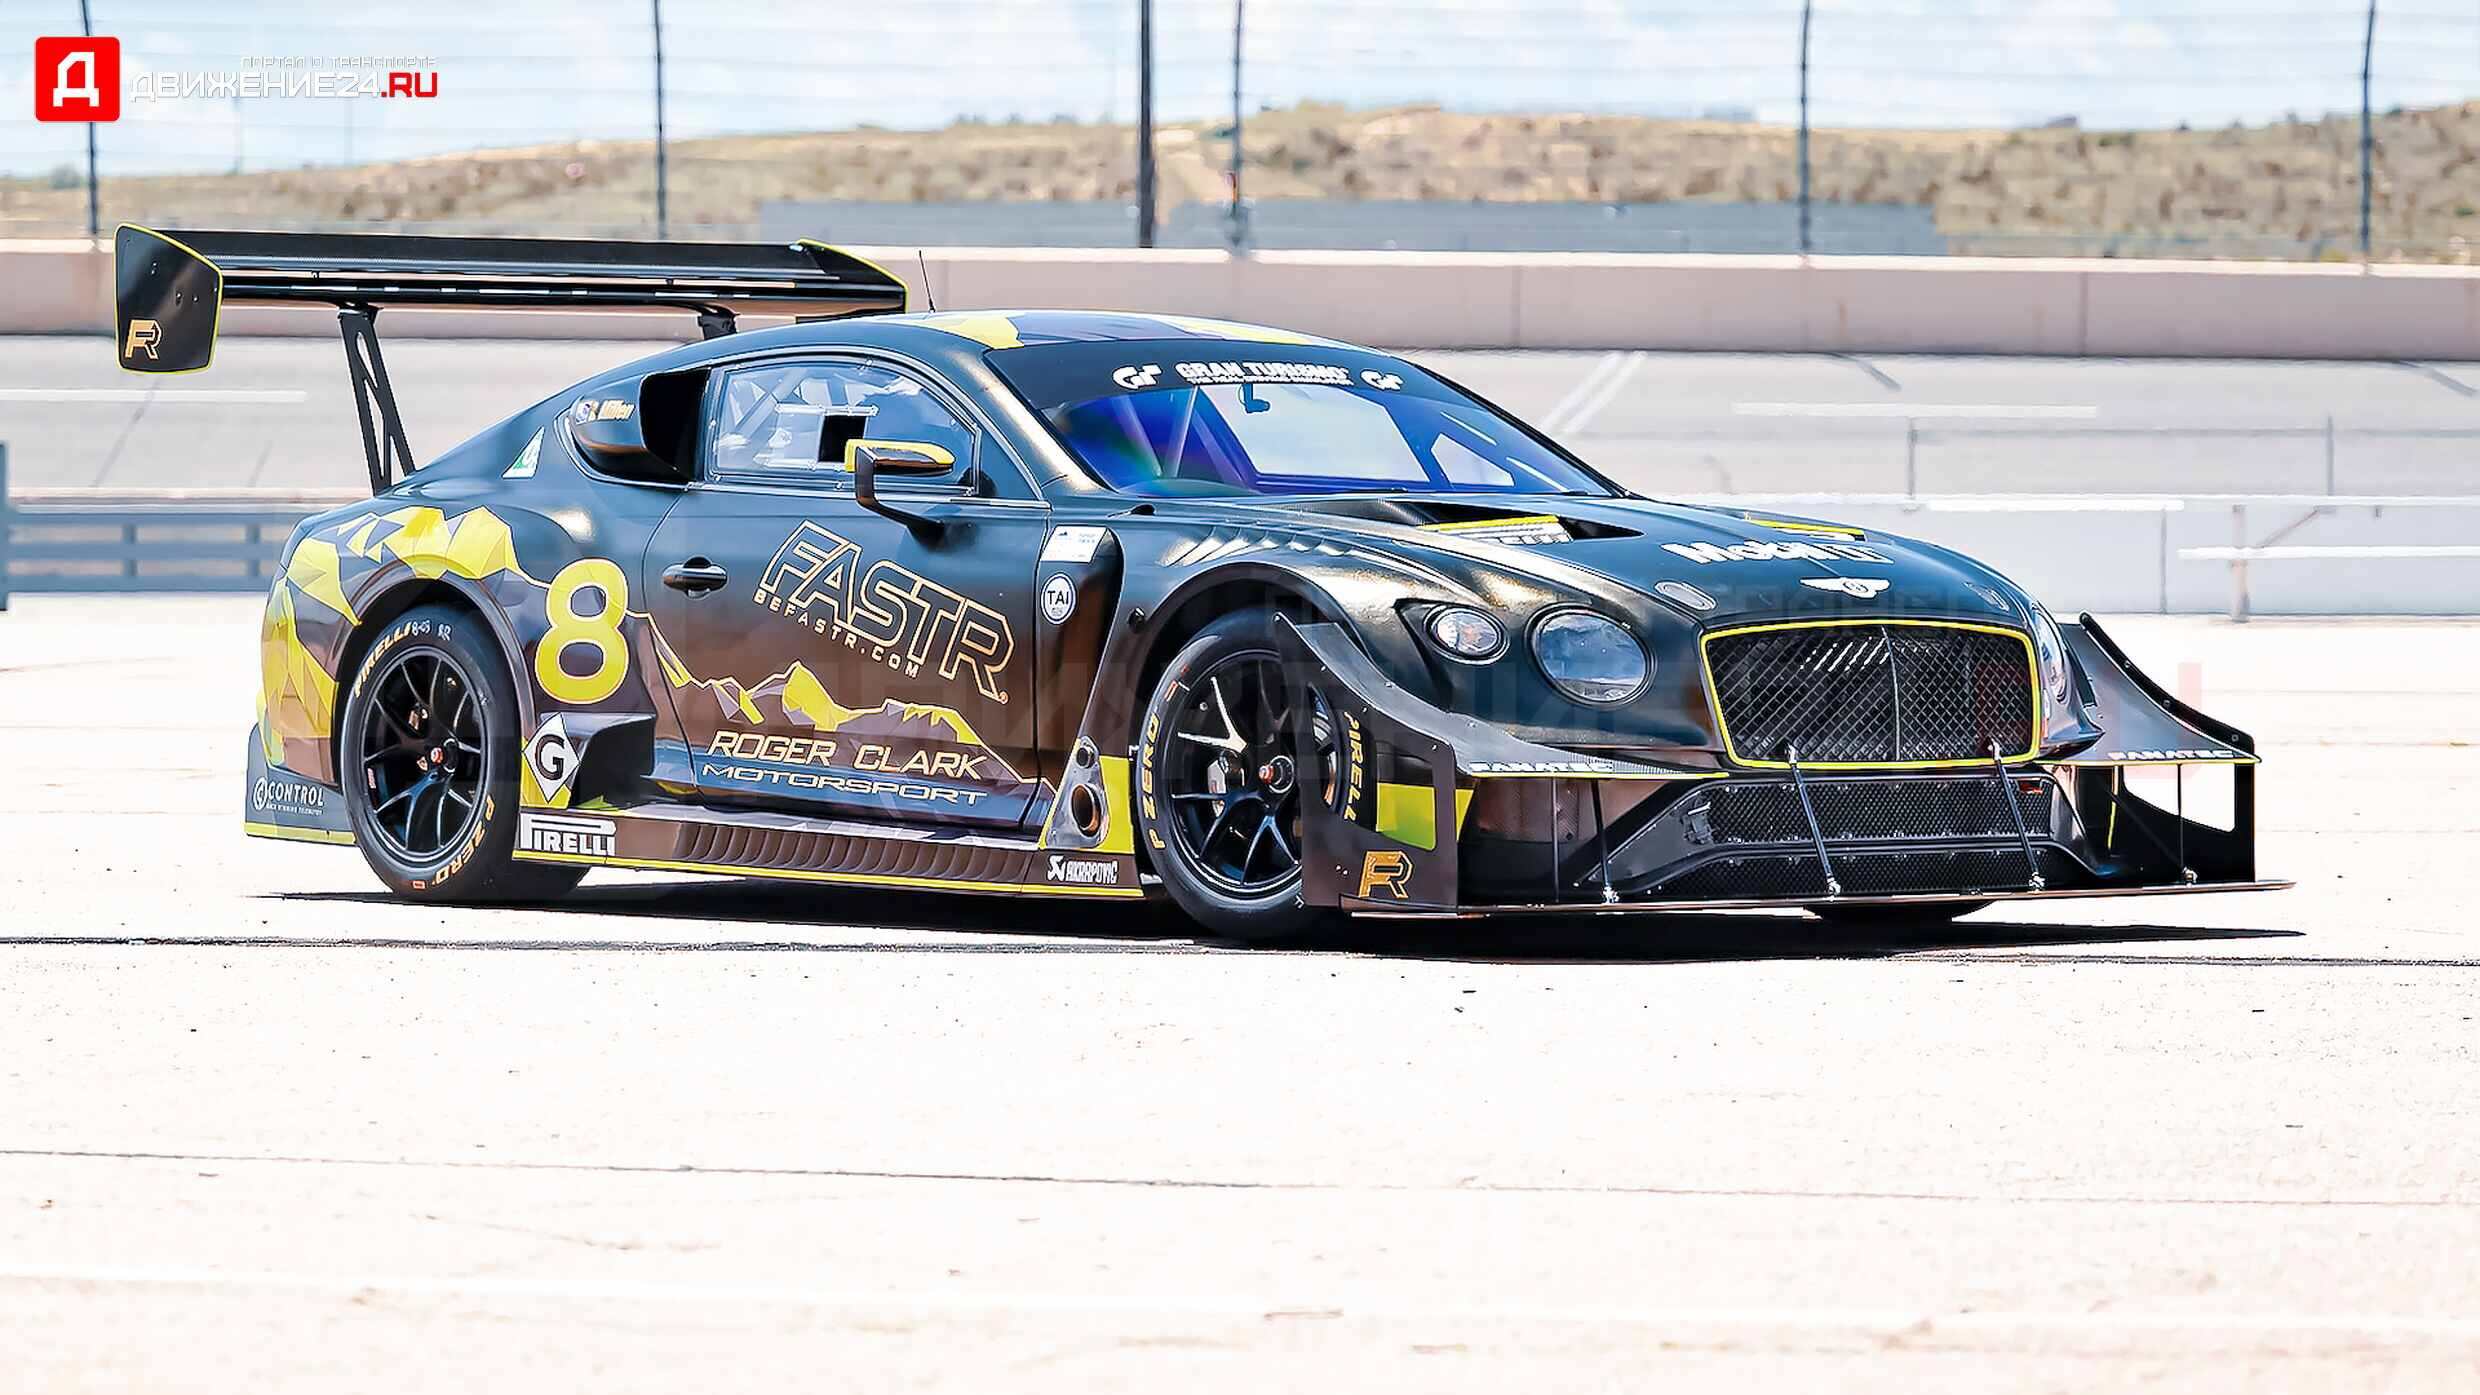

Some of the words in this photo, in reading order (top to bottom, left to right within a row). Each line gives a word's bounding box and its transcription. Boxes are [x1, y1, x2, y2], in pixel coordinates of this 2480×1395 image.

[1174, 361, 1244, 378] GRAN
[760, 519, 1015, 702] FASTR
[1047, 590, 1069, 605] TAI
[354, 621, 412, 699] PIRELLI
[534, 557, 629, 705] 8
[753, 588, 922, 678] BEFASTR.COM
[534, 734, 565, 781] G
[702, 763, 988, 806] MOTORSPORT
[706, 730, 837, 768] ROGER
[853, 744, 988, 782] CLARK
[1141, 711, 1160, 820] ZERO
[1343, 711, 1364, 823] PIRELL
[268, 781, 324, 807] CONTROL
[435, 820, 486, 885] ZERO
[520, 811, 617, 856] PIRELLI
